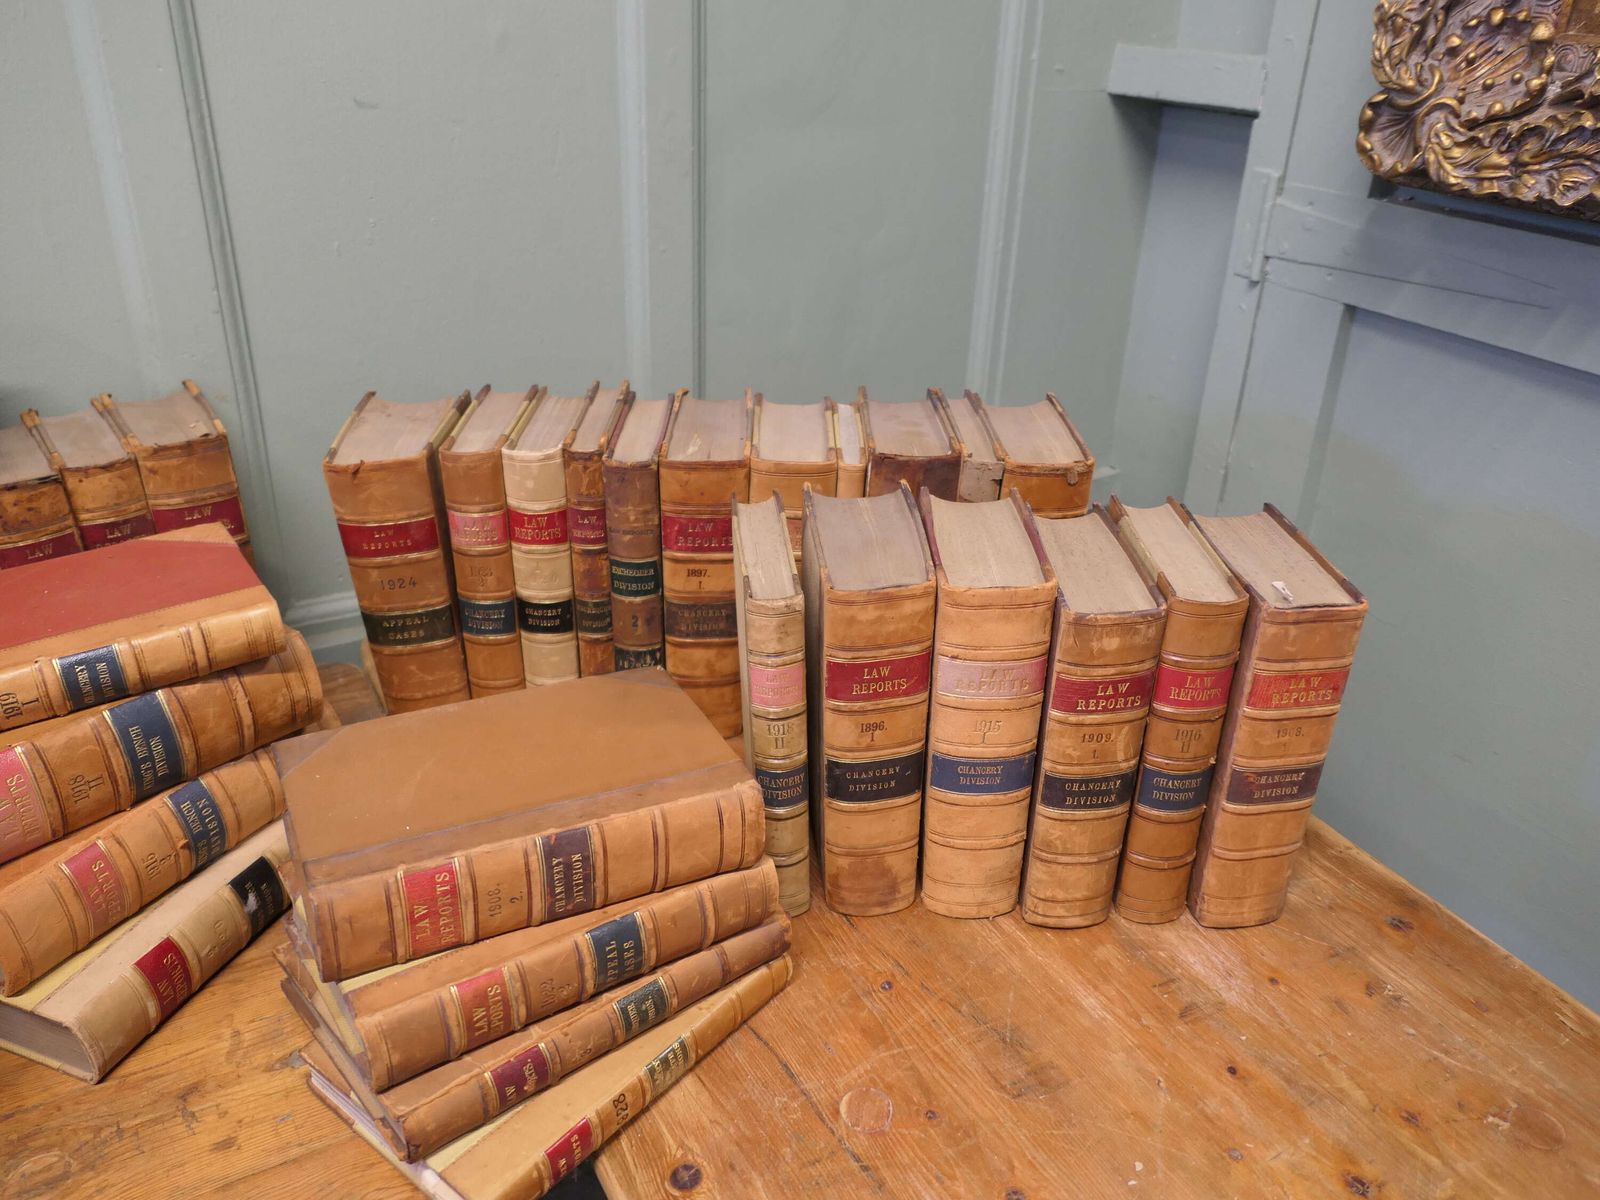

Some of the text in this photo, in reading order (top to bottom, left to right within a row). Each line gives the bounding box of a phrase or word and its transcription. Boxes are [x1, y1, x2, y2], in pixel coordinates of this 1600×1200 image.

[184, 506, 212, 520] LAW
[578, 515, 598, 524] LAW
[523, 516, 548, 528] LAW
[688, 522, 714, 532] LAW
[105, 524, 132, 539] LAW
[514, 528, 562, 540] REPORTS
[362, 540, 412, 550] REPORTS
[26, 544, 53, 560] LAW
[381, 577, 417, 590] 1924
[614, 582, 654, 592] DIVISION
[382, 616, 430, 628] APPEAL
[864, 666, 892, 679] LAW
[980, 669, 1016, 681] LAW
[852, 678, 908, 695] REPORTS
[955, 679, 1032, 693] REPORTS
[1184, 676, 1216, 688] LAW
[1290, 676, 1322, 689] LAW
[1096, 682, 1130, 696] LAW
[1169, 687, 1222, 702] REPORTS
[1076, 696, 1142, 710] REPORTS
[1271, 689, 1334, 704] REPORTS
[128, 726, 148, 760] BENCH
[150, 735, 170, 777] DIVISION
[846, 766, 900, 780] CHANCERY
[957, 766, 1004, 774] CHANCERY
[757, 772, 805, 788] CHANCERY
[960, 777, 1002, 785] DIVISION
[1153, 776, 1203, 789] CHANCERY
[1254, 772, 1306, 784] CHANCERY
[848, 780, 896, 792] DIVISION
[1065, 780, 1122, 791] CHANCERY
[1254, 786, 1300, 798] DIVISION
[1066, 794, 1117, 806] DIVISION
[1152, 790, 1196, 801] DIVISION
[180, 800, 203, 835] BENCH
[552, 856, 566, 912] CHANCERY
[572, 853, 586, 904] DIVISION
[435, 872, 456, 944] REPORTS
[413, 903, 432, 940] LAW
[472, 1007, 489, 1036] LAW
